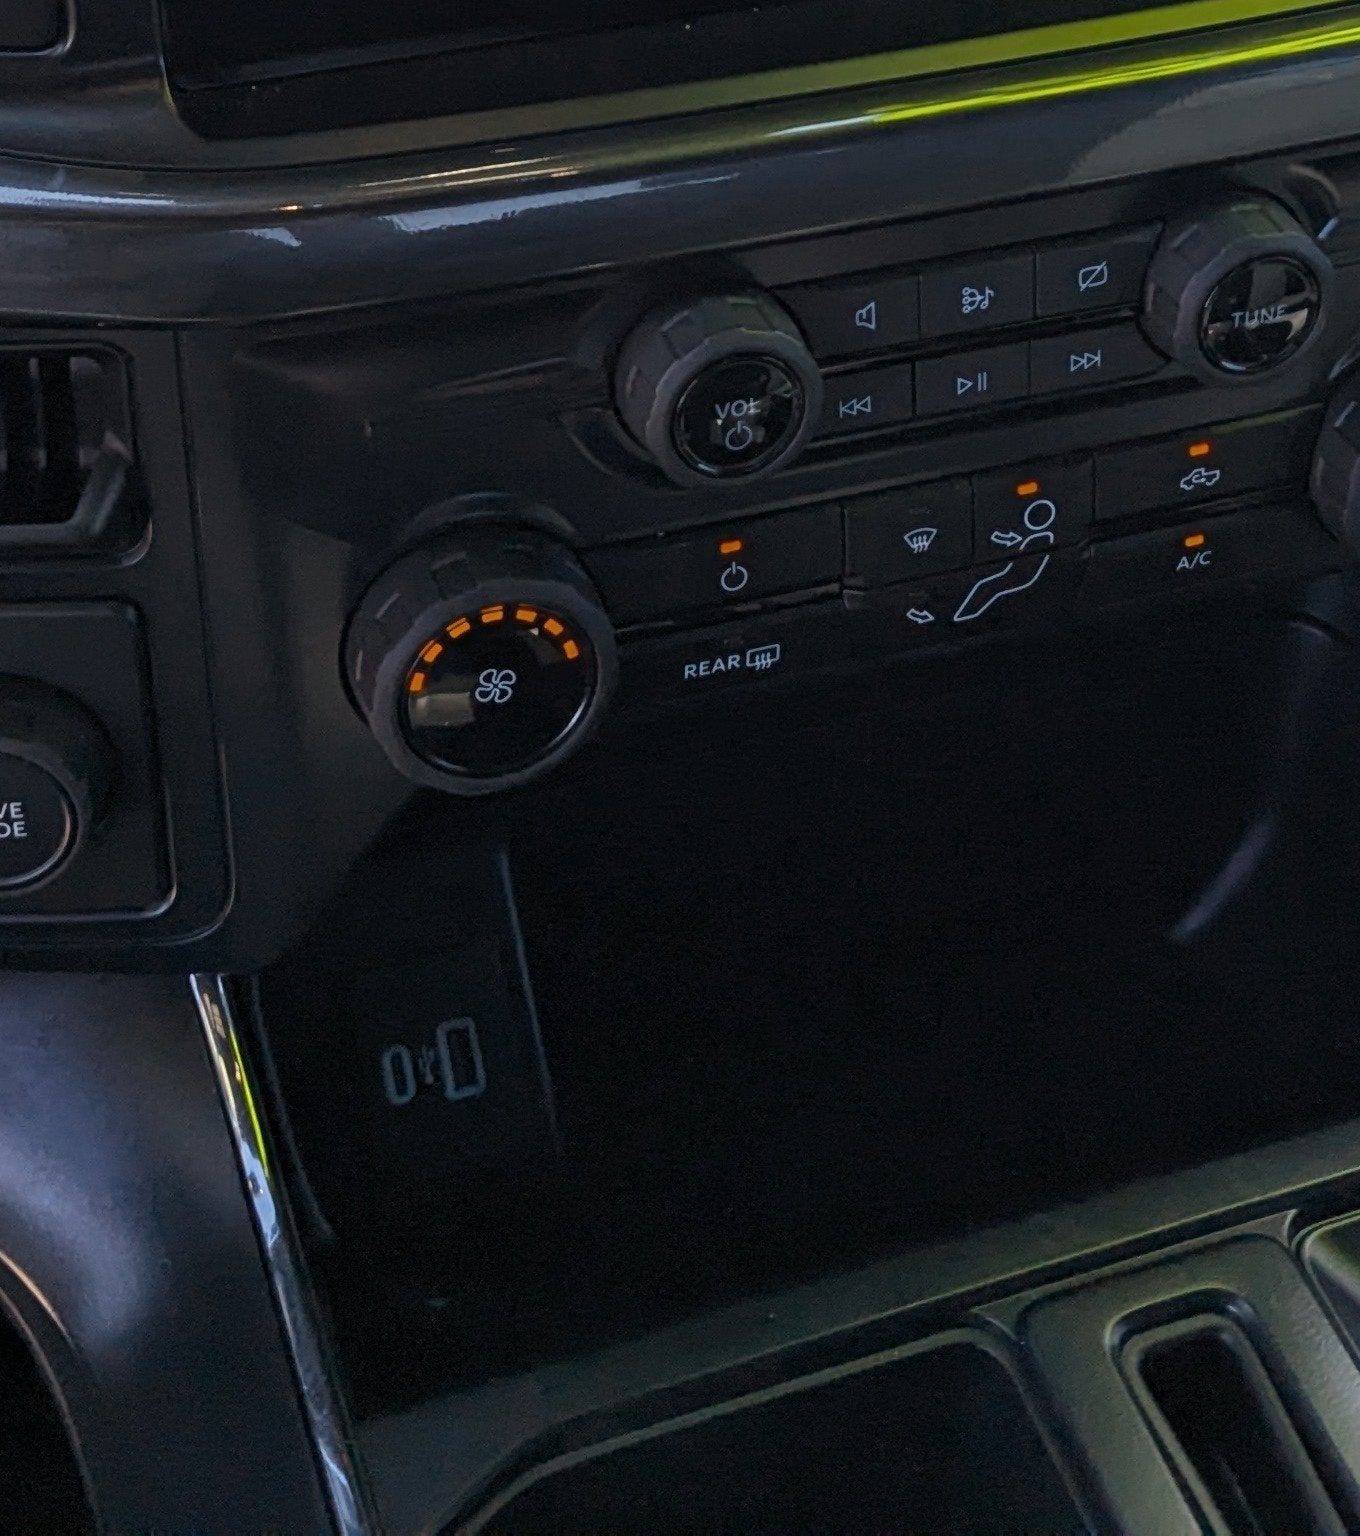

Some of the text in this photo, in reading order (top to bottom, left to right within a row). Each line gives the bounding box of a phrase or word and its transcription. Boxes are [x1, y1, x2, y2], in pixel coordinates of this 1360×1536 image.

[1232, 302, 1288, 328] TUNE
[715, 397, 760, 421] VOL
[1175, 550, 1213, 571] A/C
[684, 654, 741, 680] REAR
